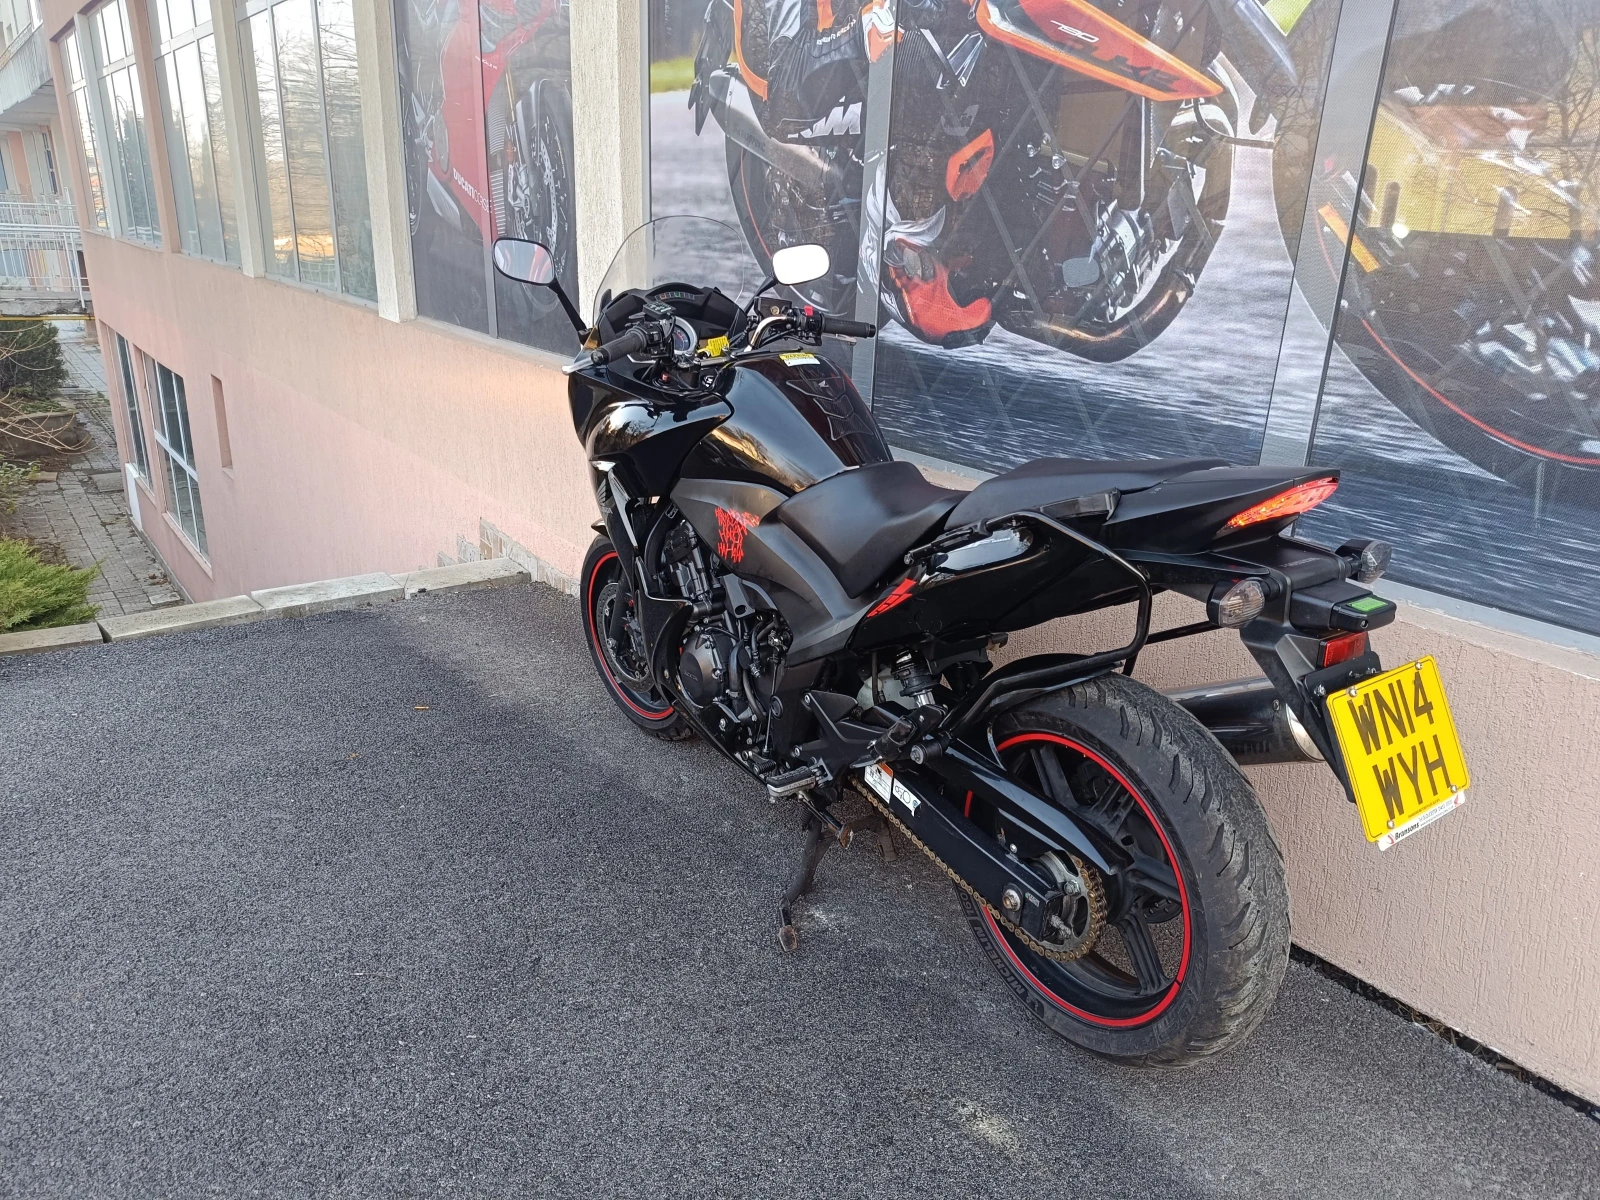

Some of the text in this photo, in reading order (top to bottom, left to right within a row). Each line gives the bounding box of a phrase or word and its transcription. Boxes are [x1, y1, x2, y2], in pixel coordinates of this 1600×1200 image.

[1347, 671, 1434, 756] WN14
[1371, 734, 1451, 820] WYH
[974, 926, 1026, 997] MICHELIN
